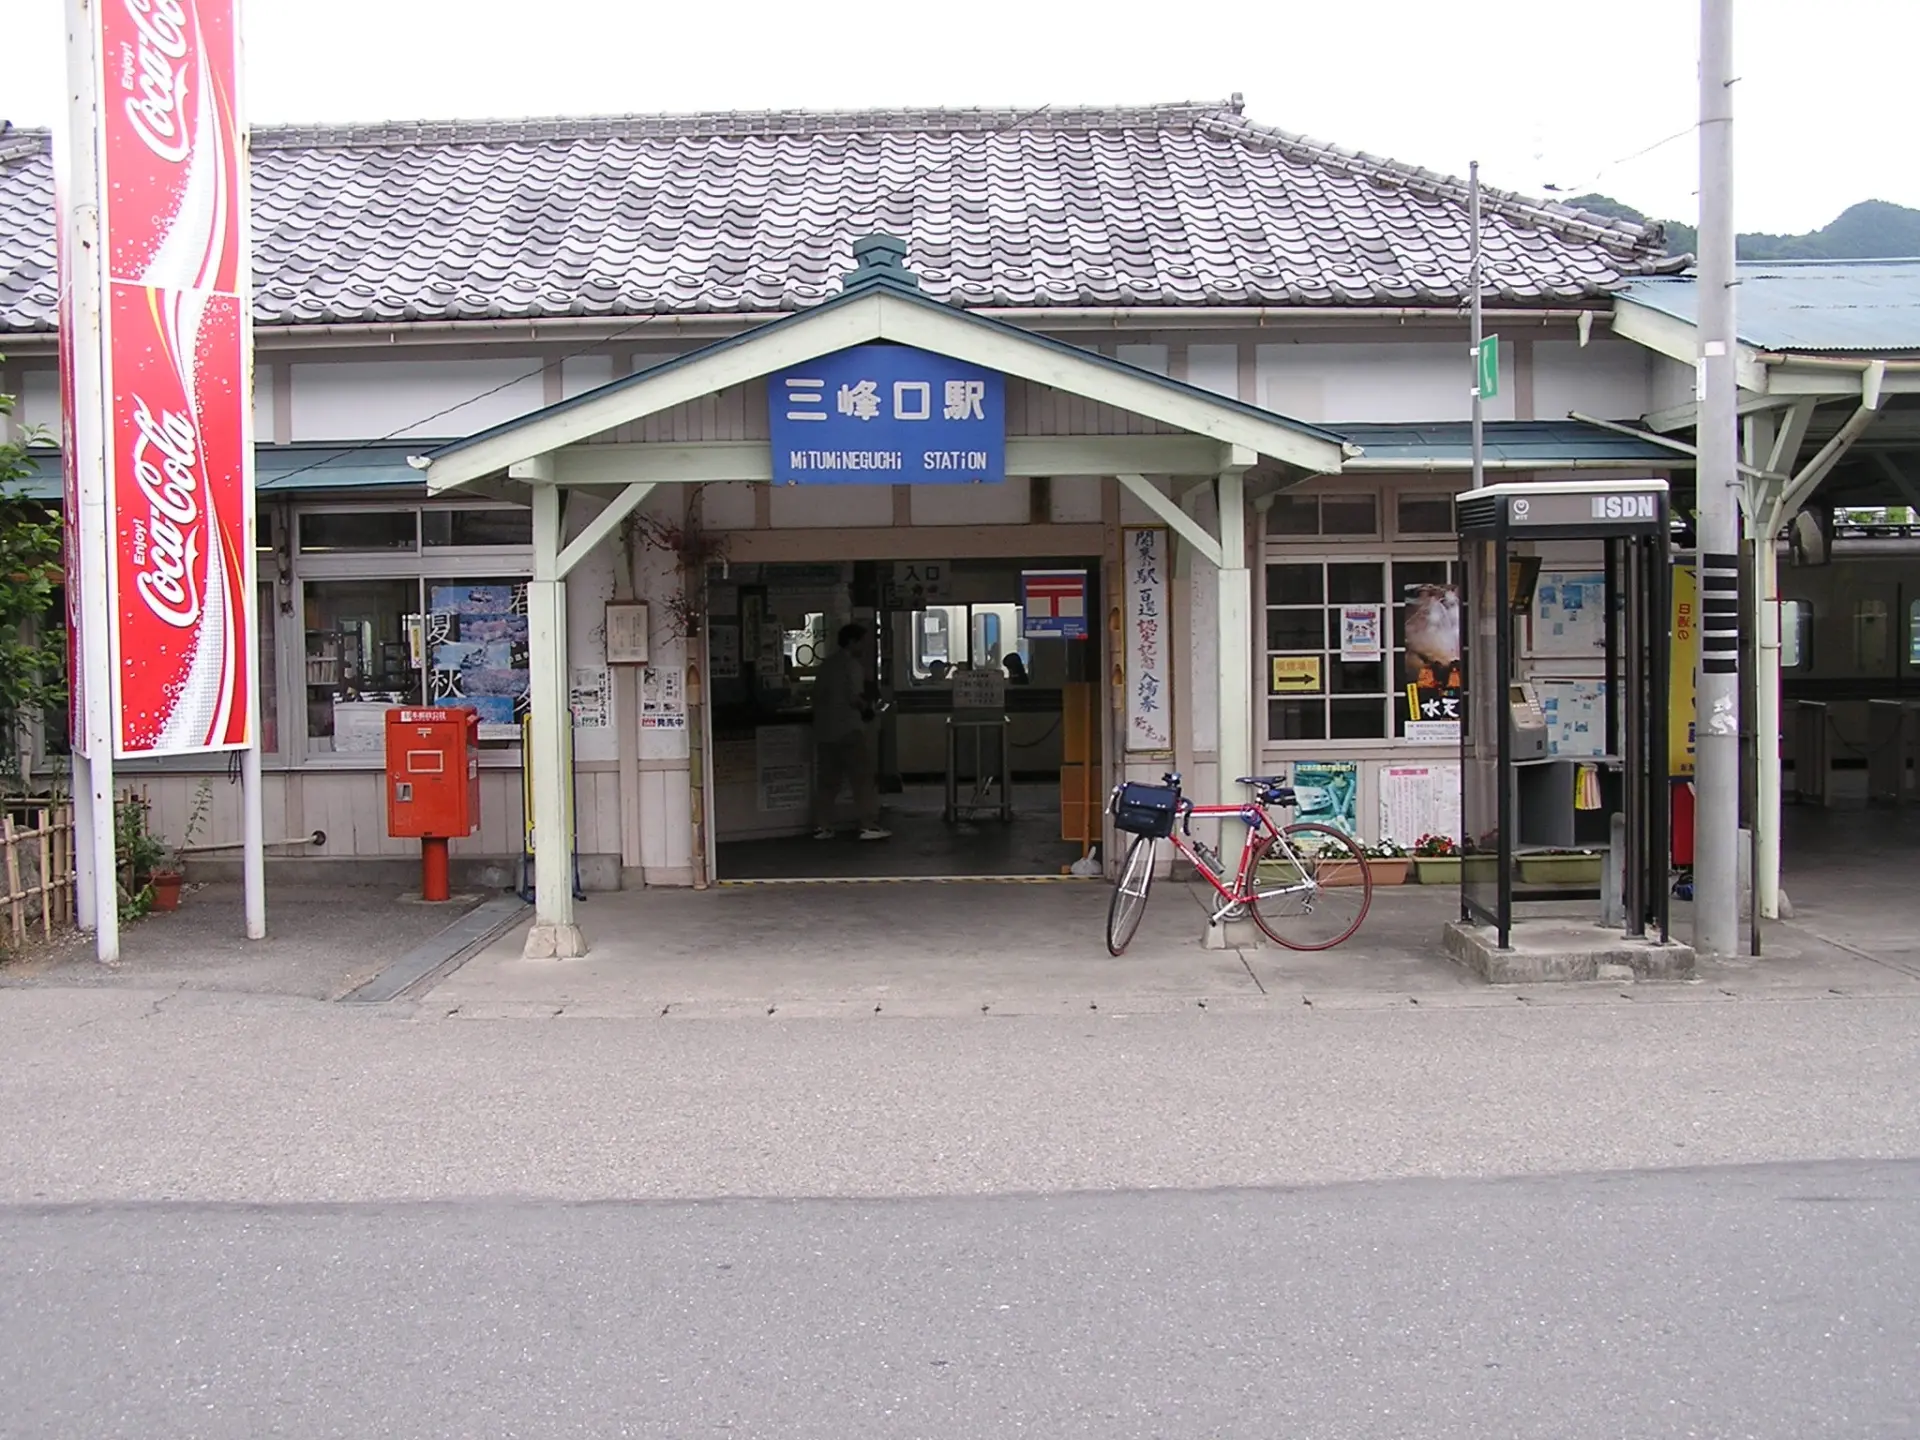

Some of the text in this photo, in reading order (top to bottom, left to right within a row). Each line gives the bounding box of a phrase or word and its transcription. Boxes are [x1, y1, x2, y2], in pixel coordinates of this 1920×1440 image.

[120, 41, 136, 91] Enjoy!
[125, 0, 190, 163] Coca-Co
[785, 378, 985, 421] 三峰口駅
[131, 392, 201, 629] Coca-Cola
[1591, 496, 1653, 519] ISDN
[133, 518, 148, 566] Enjoy!
[904, 565, 940, 582] 入口
[426, 612, 462, 646] 夏
[430, 668, 467, 699] 秋
